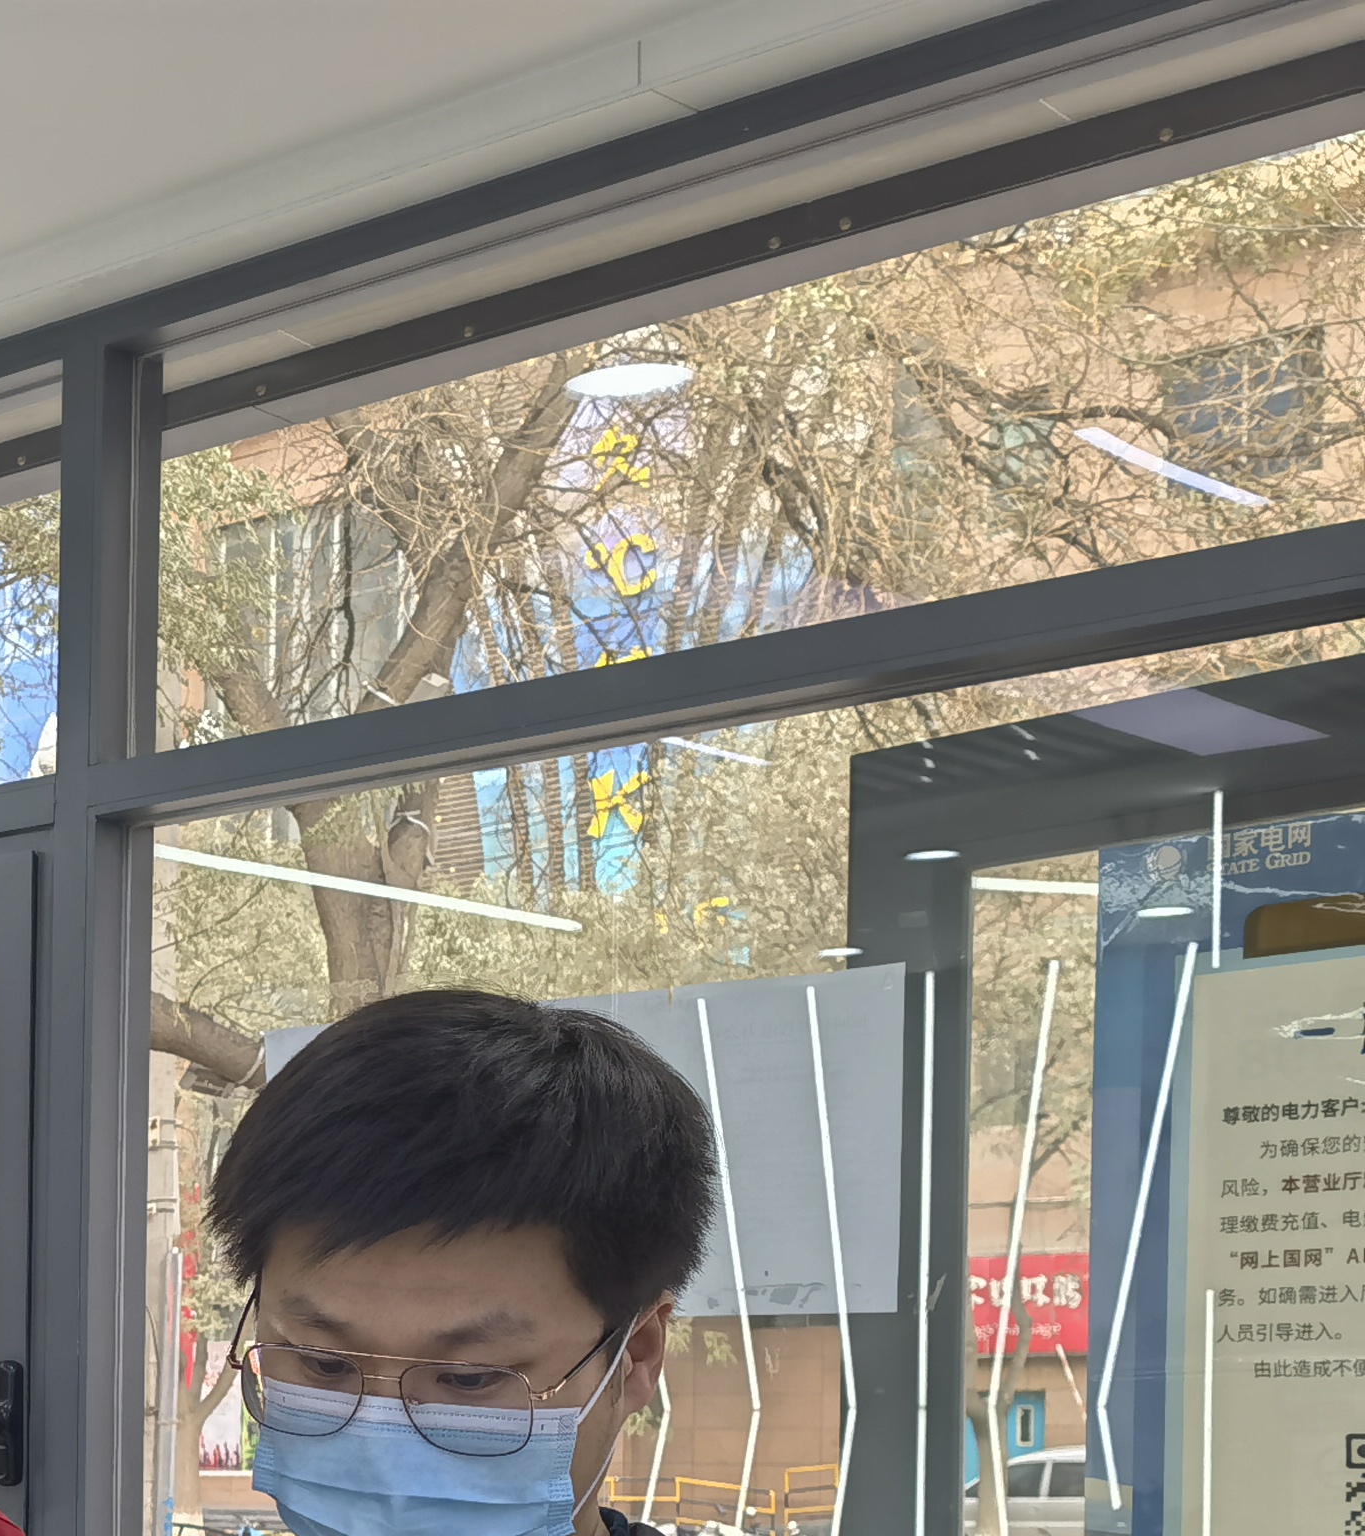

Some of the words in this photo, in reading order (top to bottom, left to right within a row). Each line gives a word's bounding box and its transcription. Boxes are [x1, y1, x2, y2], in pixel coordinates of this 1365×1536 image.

[1265, 851, 1311, 870] GRID
[1222, 1097, 1365, 1125] 尊敬的电力客户
[1260, 1133, 1365, 1159] 为确保您的
[1221, 1171, 1365, 1198] 风险，本营业厅
[1220, 1209, 1365, 1234] 理缴费充值、电
[1346, 1248, 1365, 1265] A
[1217, 1322, 1342, 1343] 人员引导进入。
